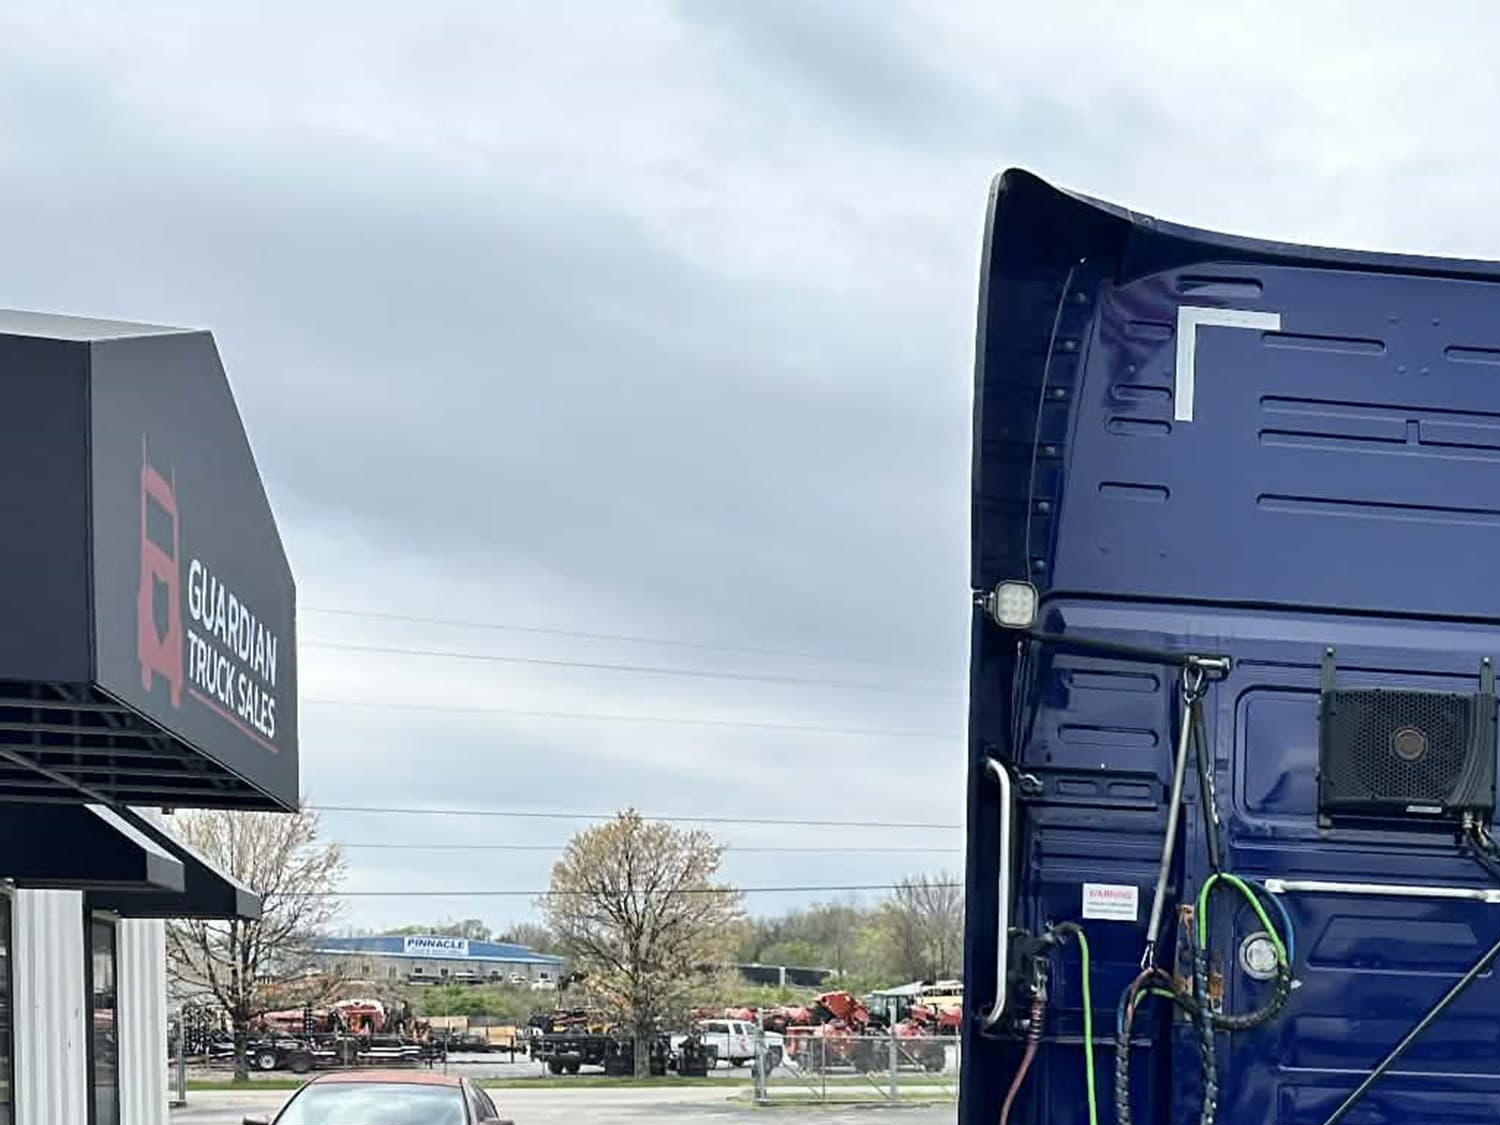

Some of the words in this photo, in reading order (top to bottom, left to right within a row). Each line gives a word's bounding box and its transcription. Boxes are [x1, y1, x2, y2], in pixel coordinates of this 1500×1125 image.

[188, 558, 277, 688] GUARDIAN
[187, 629, 236, 710] TRUCK
[238, 672, 276, 739] SALES
[407, 939, 465, 950] PINNACLE
